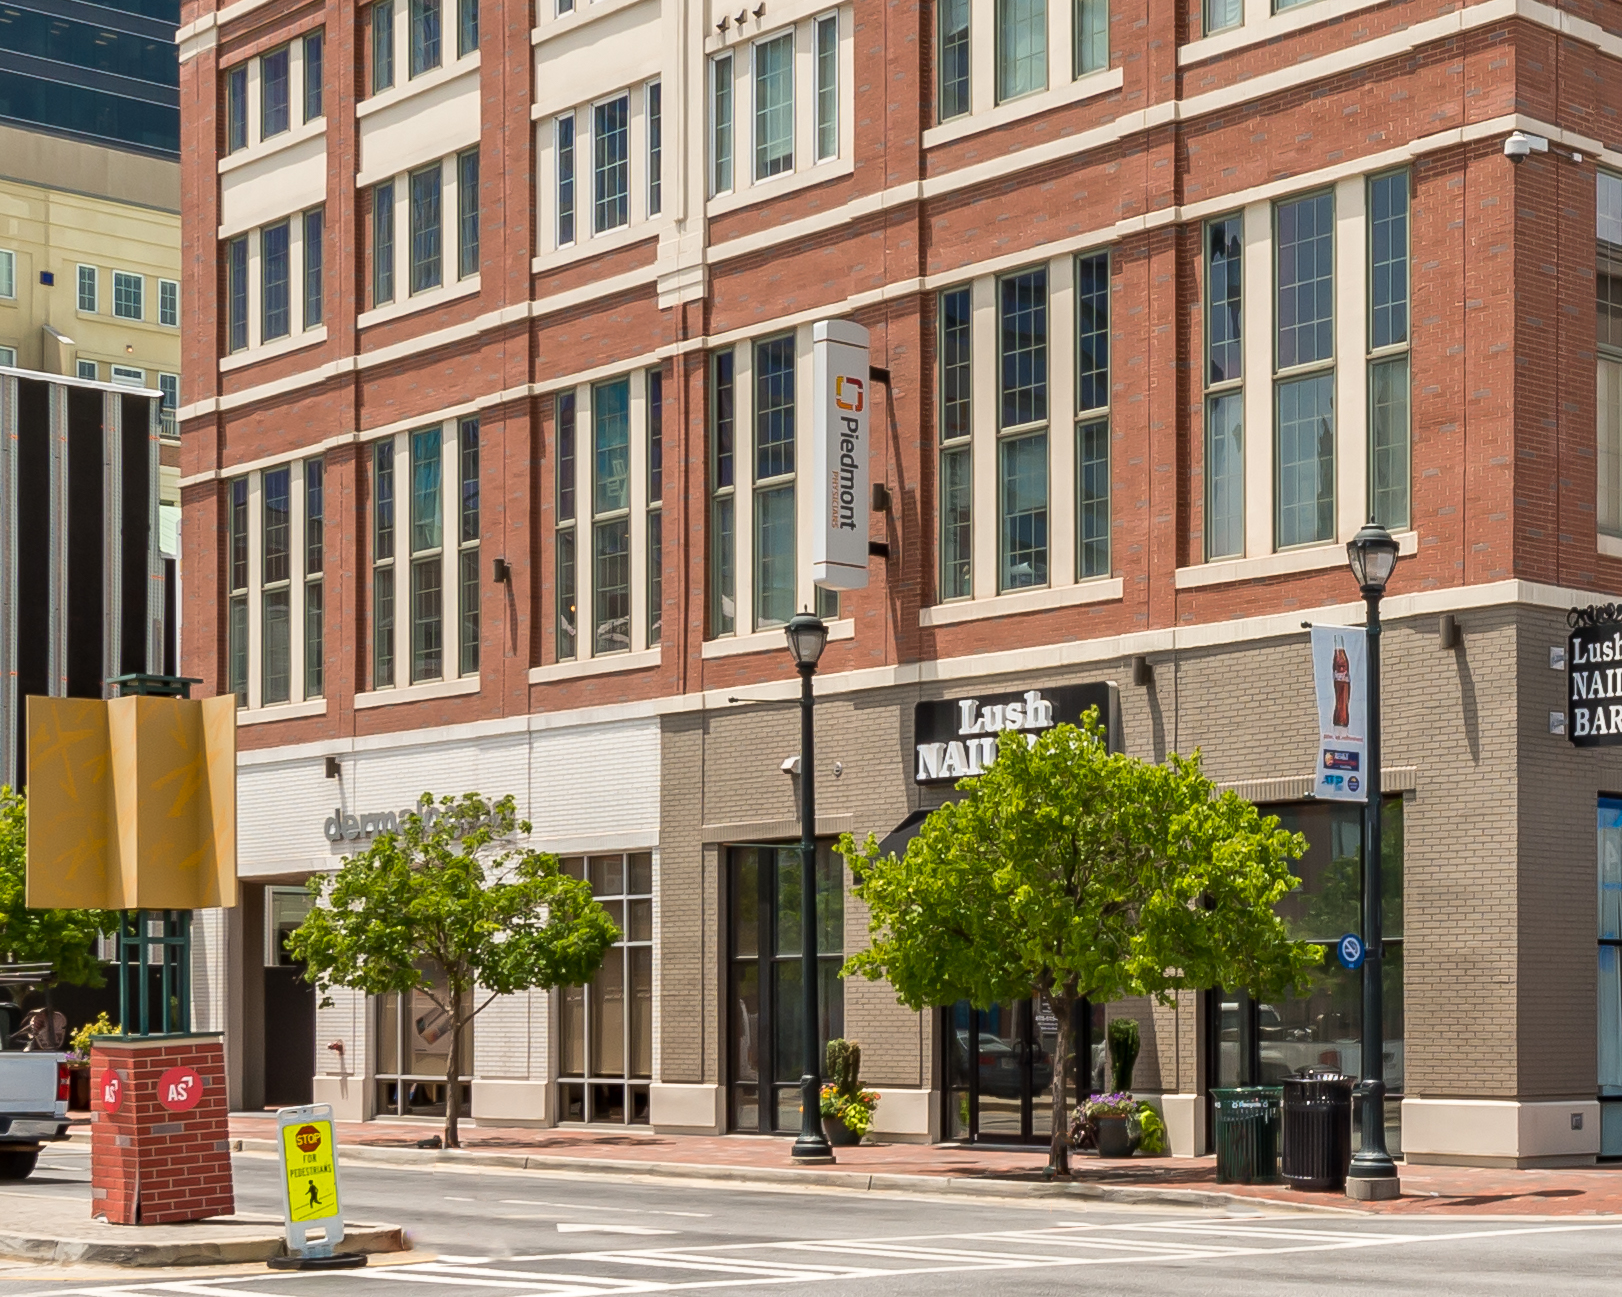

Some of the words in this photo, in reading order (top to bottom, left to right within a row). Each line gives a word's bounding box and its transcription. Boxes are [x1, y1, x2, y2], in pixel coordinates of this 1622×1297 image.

[840, 415, 860, 532] Piedmont
[831, 470, 840, 529] PHYSICIANS
[958, 690, 1054, 735] Lush
[104, 1085, 116, 1103] AS
[167, 1083, 188, 1102] AS
[296, 1132, 321, 1146] STOP
[303, 1154, 317, 1163] FOR
[290, 1163, 332, 1178] PEDESTRIANS
